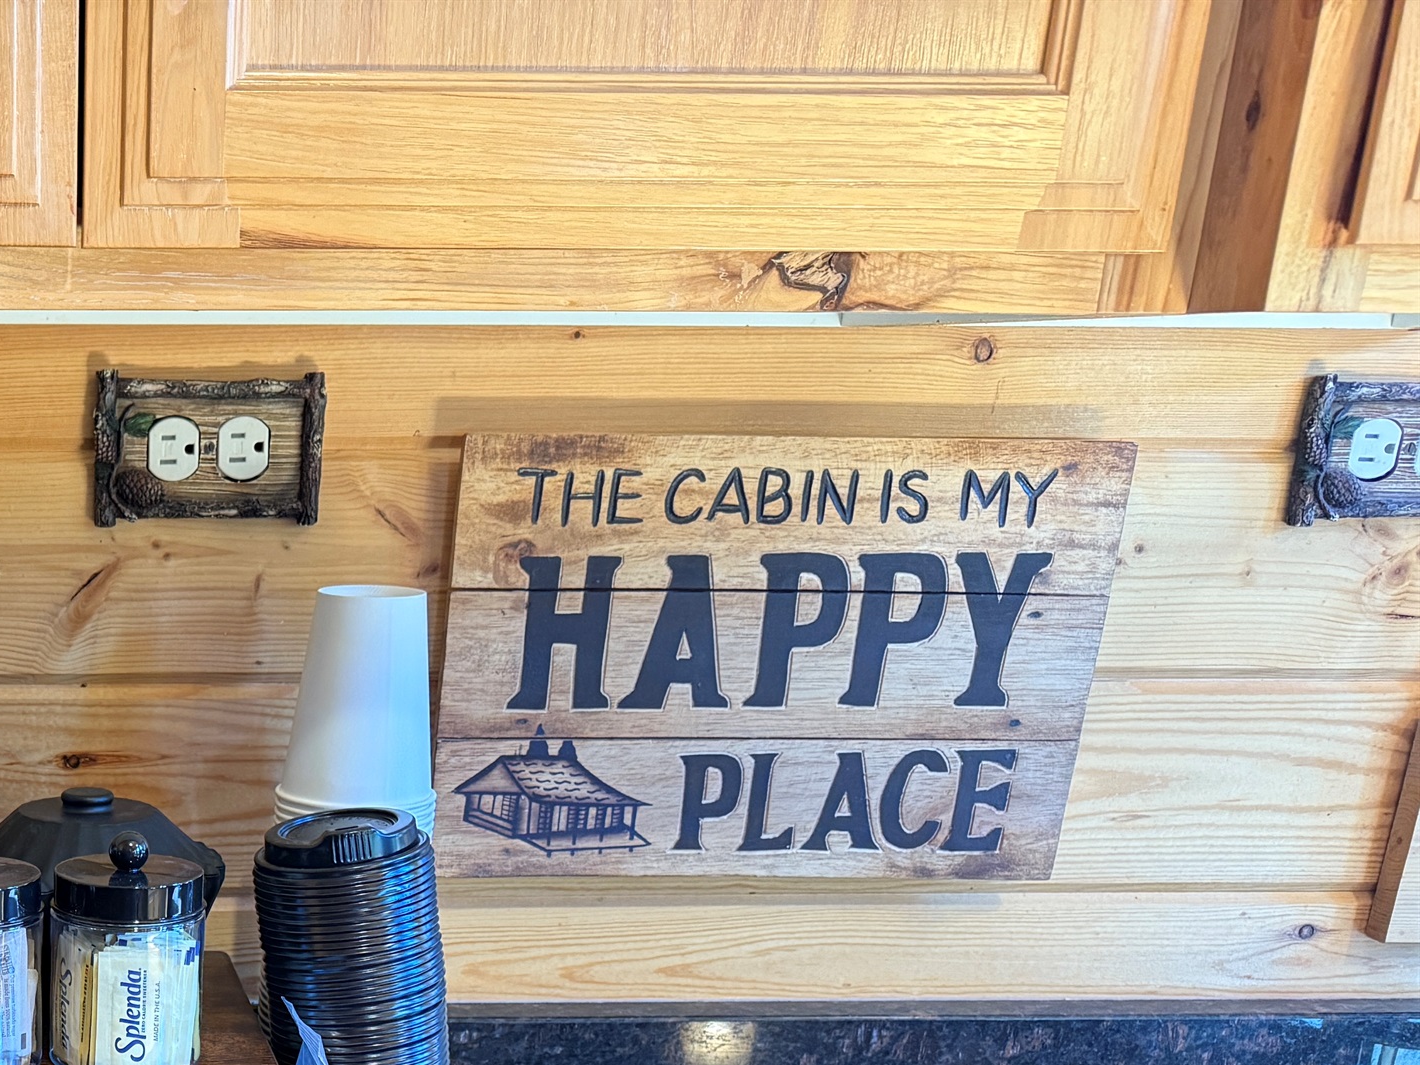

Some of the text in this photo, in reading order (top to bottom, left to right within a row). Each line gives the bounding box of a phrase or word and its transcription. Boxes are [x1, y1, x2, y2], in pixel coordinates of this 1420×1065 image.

[518, 467, 1059, 529] THE CABIN IS MY
[507, 552, 1054, 710] HAPPY
[673, 748, 1017, 852] PLACE
[60, 958, 73, 1050] Splenda
[153, 1014, 160, 1022] IN
